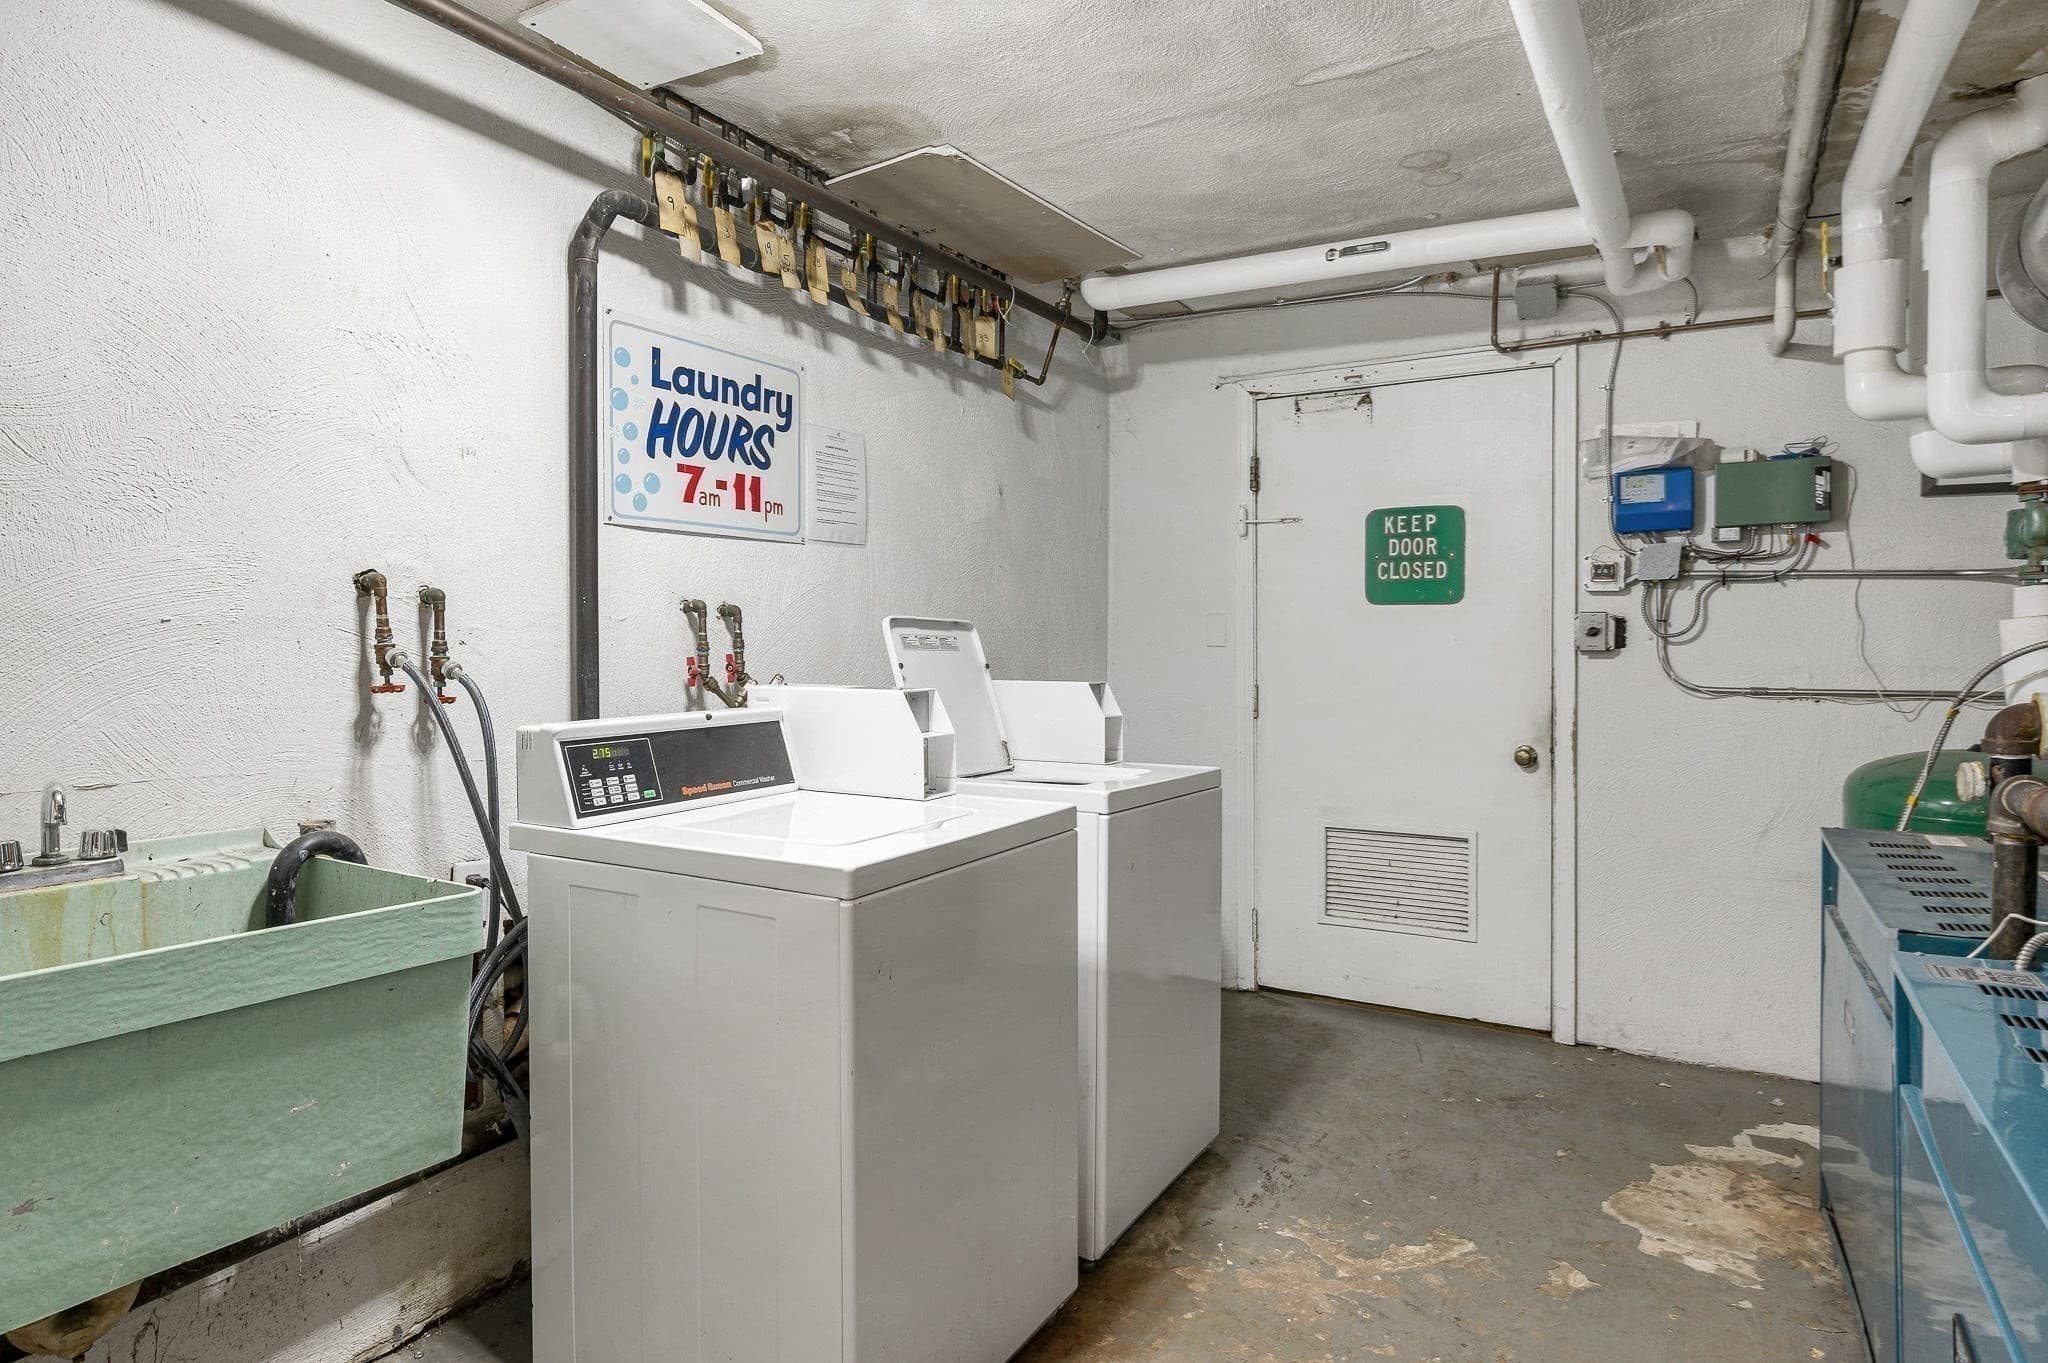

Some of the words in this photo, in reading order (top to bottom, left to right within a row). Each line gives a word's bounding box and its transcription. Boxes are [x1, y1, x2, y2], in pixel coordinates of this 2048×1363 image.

[666, 195, 676, 212] 9
[651, 346, 793, 433] Laundry
[646, 397, 775, 471] HOURS
[1384, 513, 1437, 534] KEEP
[1388, 537, 1438, 556] DOOR
[1377, 561, 1447, 580] CLOSED
[681, 783, 708, 796] Speed
[707, 781, 733, 792] Queen
[732, 777, 759, 788] Commercial
